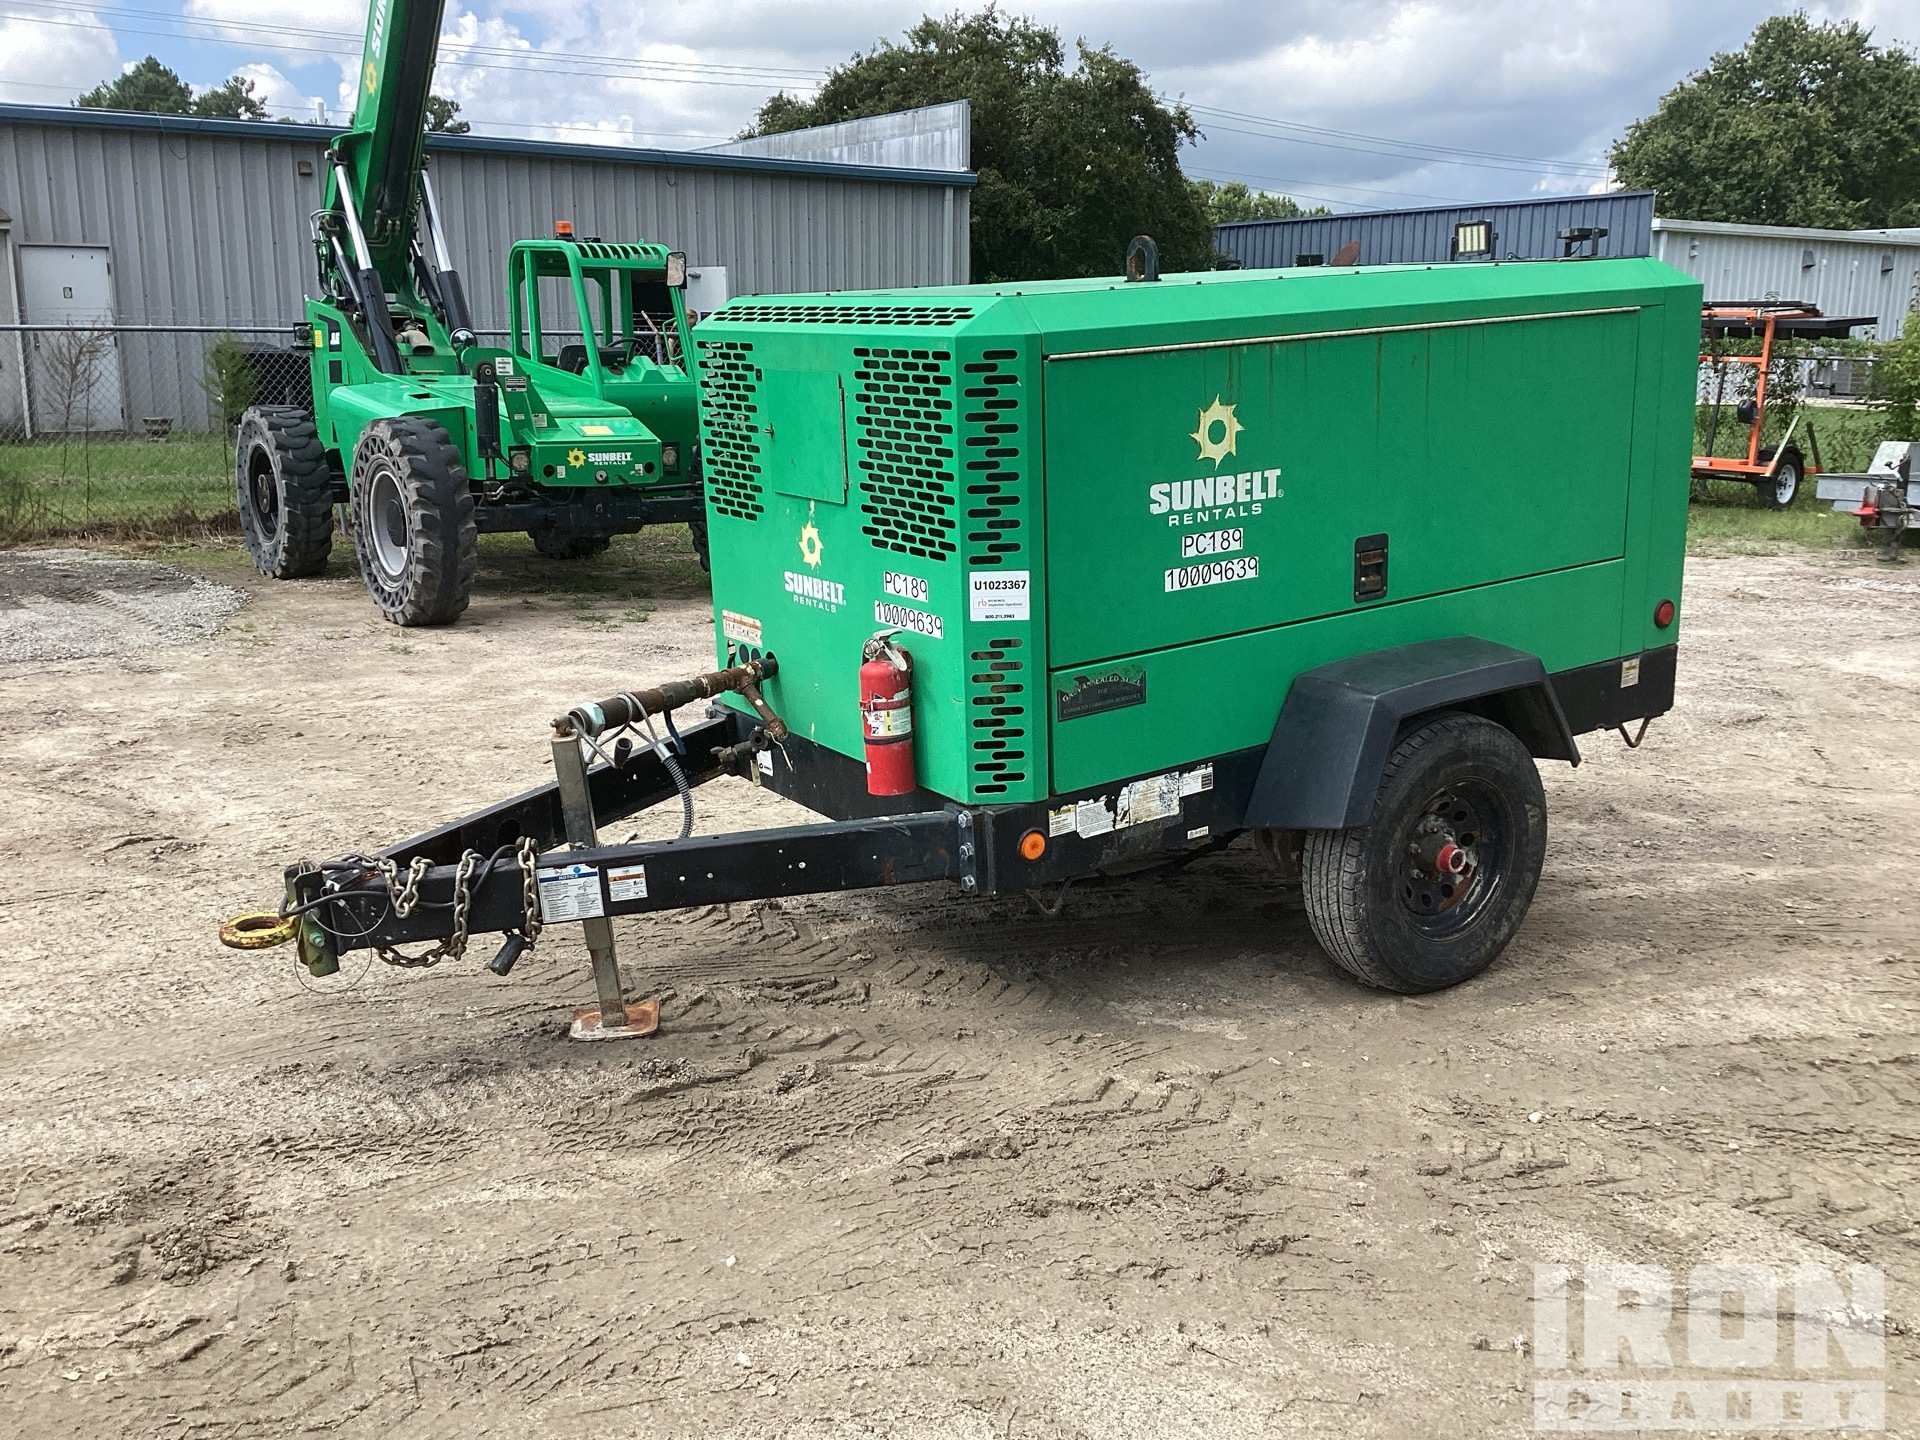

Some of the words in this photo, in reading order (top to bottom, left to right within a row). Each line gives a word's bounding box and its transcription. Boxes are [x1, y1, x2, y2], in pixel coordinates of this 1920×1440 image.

[588, 452, 632, 462] SUNBELT
[1150, 468, 1281, 515] SUNBELT
[1168, 503, 1262, 527] RENTALS
[1183, 529, 1242, 556] PC189
[884, 571, 928, 601] PC189
[974, 580, 1027, 590] U1023367
[1167, 557, 1258, 589] 10009639
[784, 570, 845, 606] SUNBELT
[793, 594, 837, 613] RENTALS
[876, 601, 943, 637] 10009639
